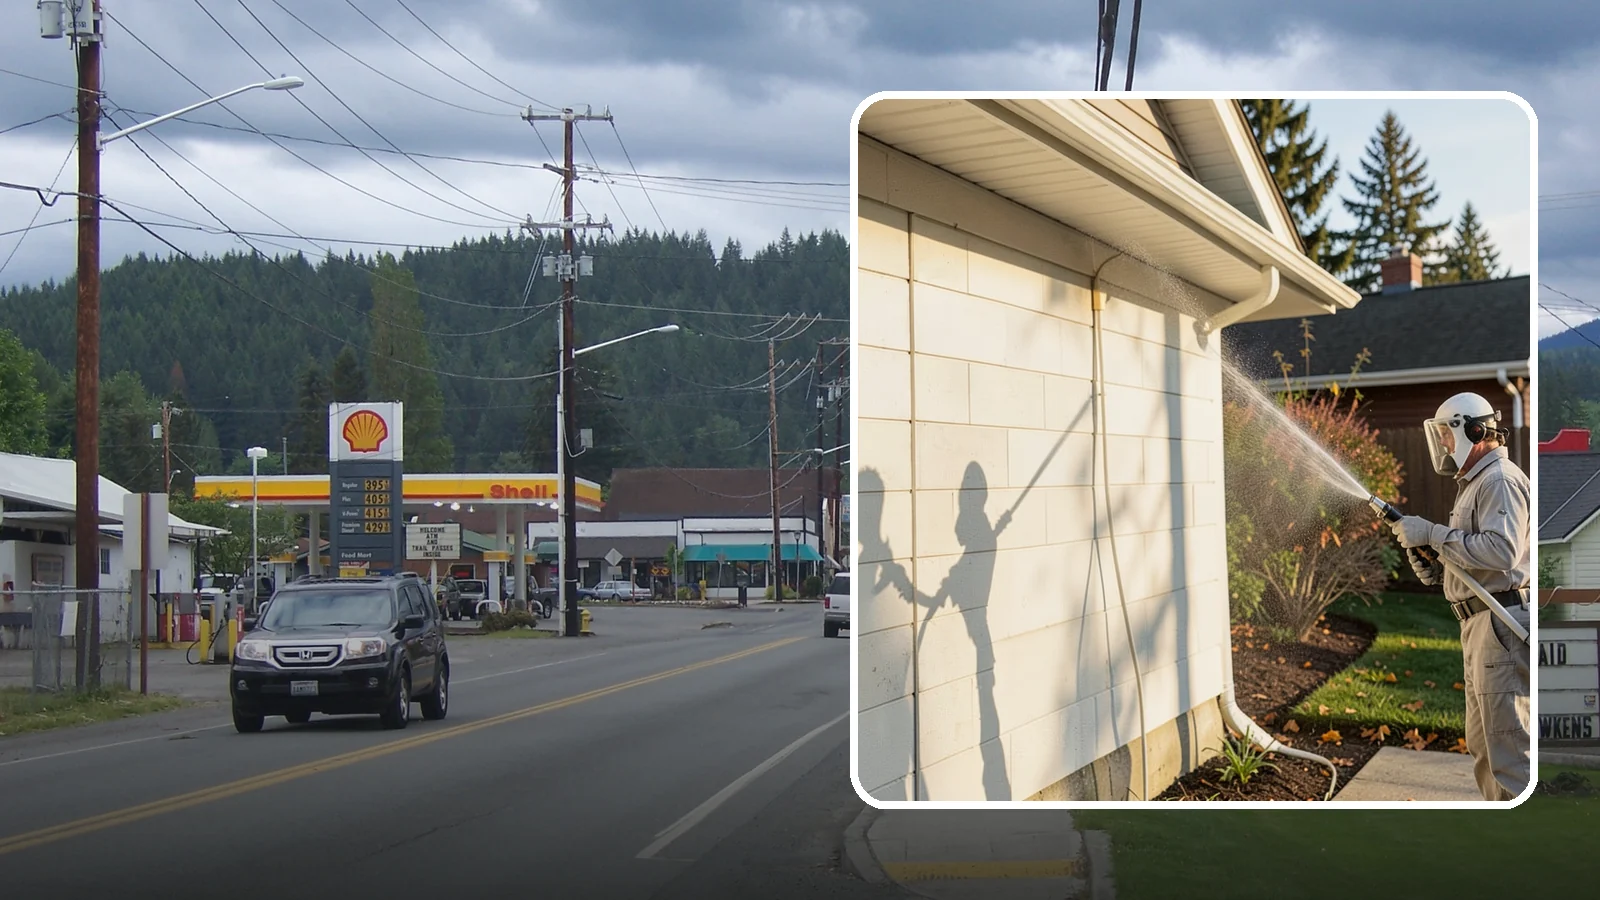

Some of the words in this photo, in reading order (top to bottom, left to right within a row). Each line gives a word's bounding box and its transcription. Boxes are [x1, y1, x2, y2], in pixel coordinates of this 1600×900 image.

[366, 480, 383, 490] 395
[490, 484, 547, 499] Shell
[366, 494, 383, 504] 405
[366, 508, 383, 518] 415
[366, 522, 383, 532] 429
[1538, 642, 1567, 666] AID
[1538, 715, 1592, 739] WKENS
